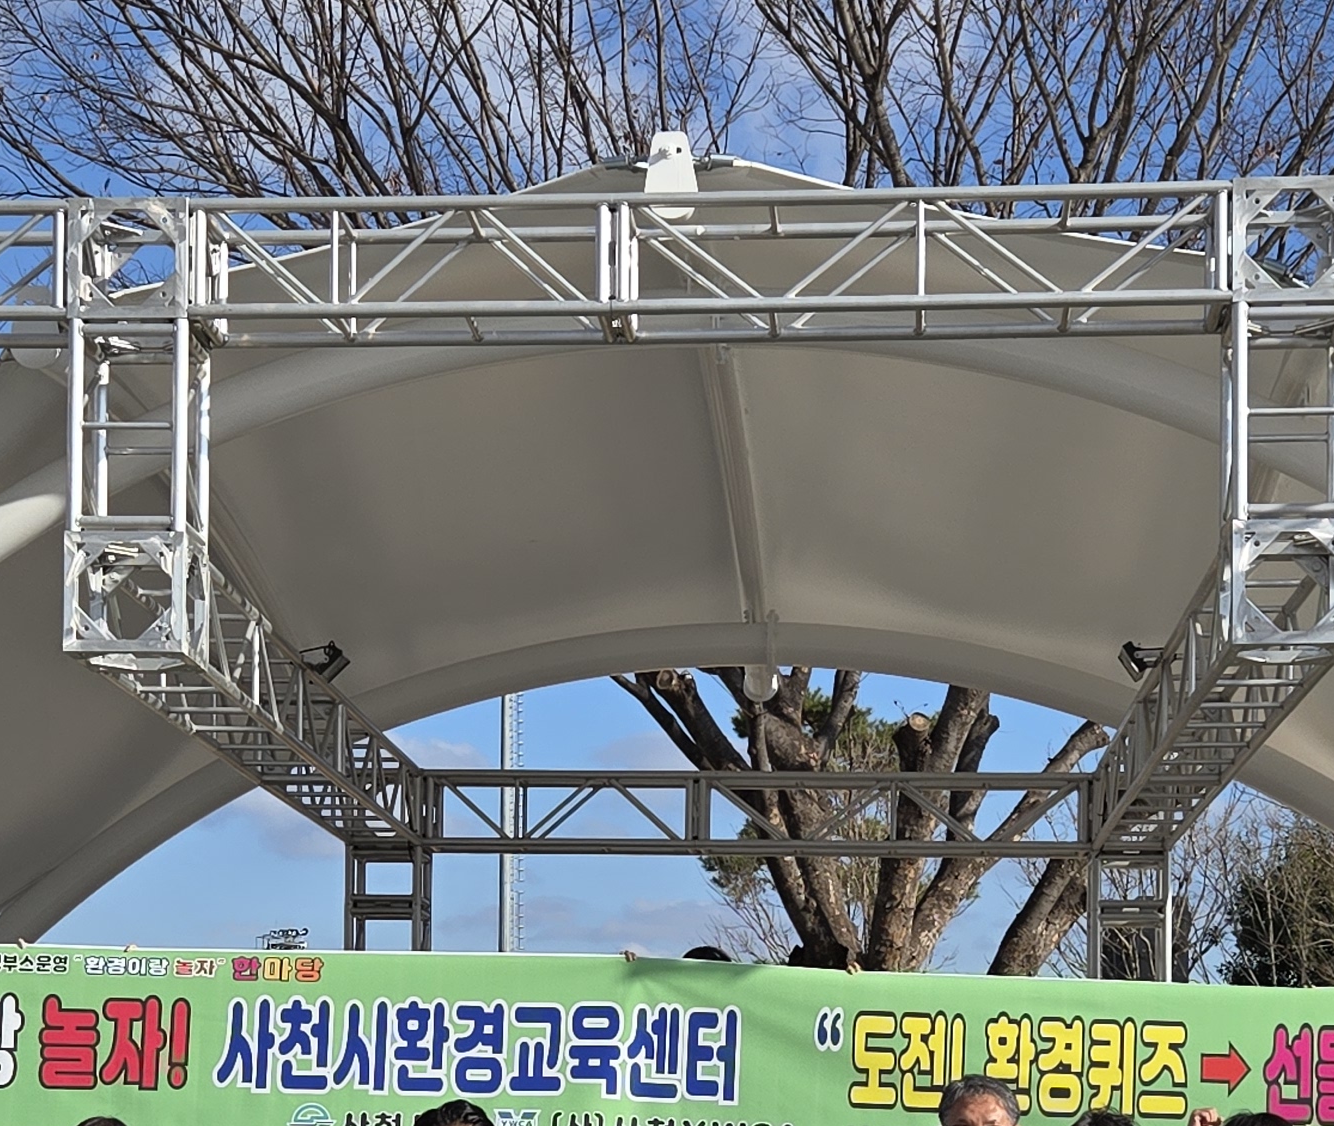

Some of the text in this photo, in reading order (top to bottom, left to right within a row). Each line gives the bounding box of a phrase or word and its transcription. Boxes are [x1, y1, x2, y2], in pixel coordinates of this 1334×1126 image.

[232, 956, 324, 982] 한마당
[39, 994, 192, 1090] 놀자!
[215, 997, 739, 1103] 사천시환경교육센터
[985, 1012, 1188, 1119] 환경퀴즈
